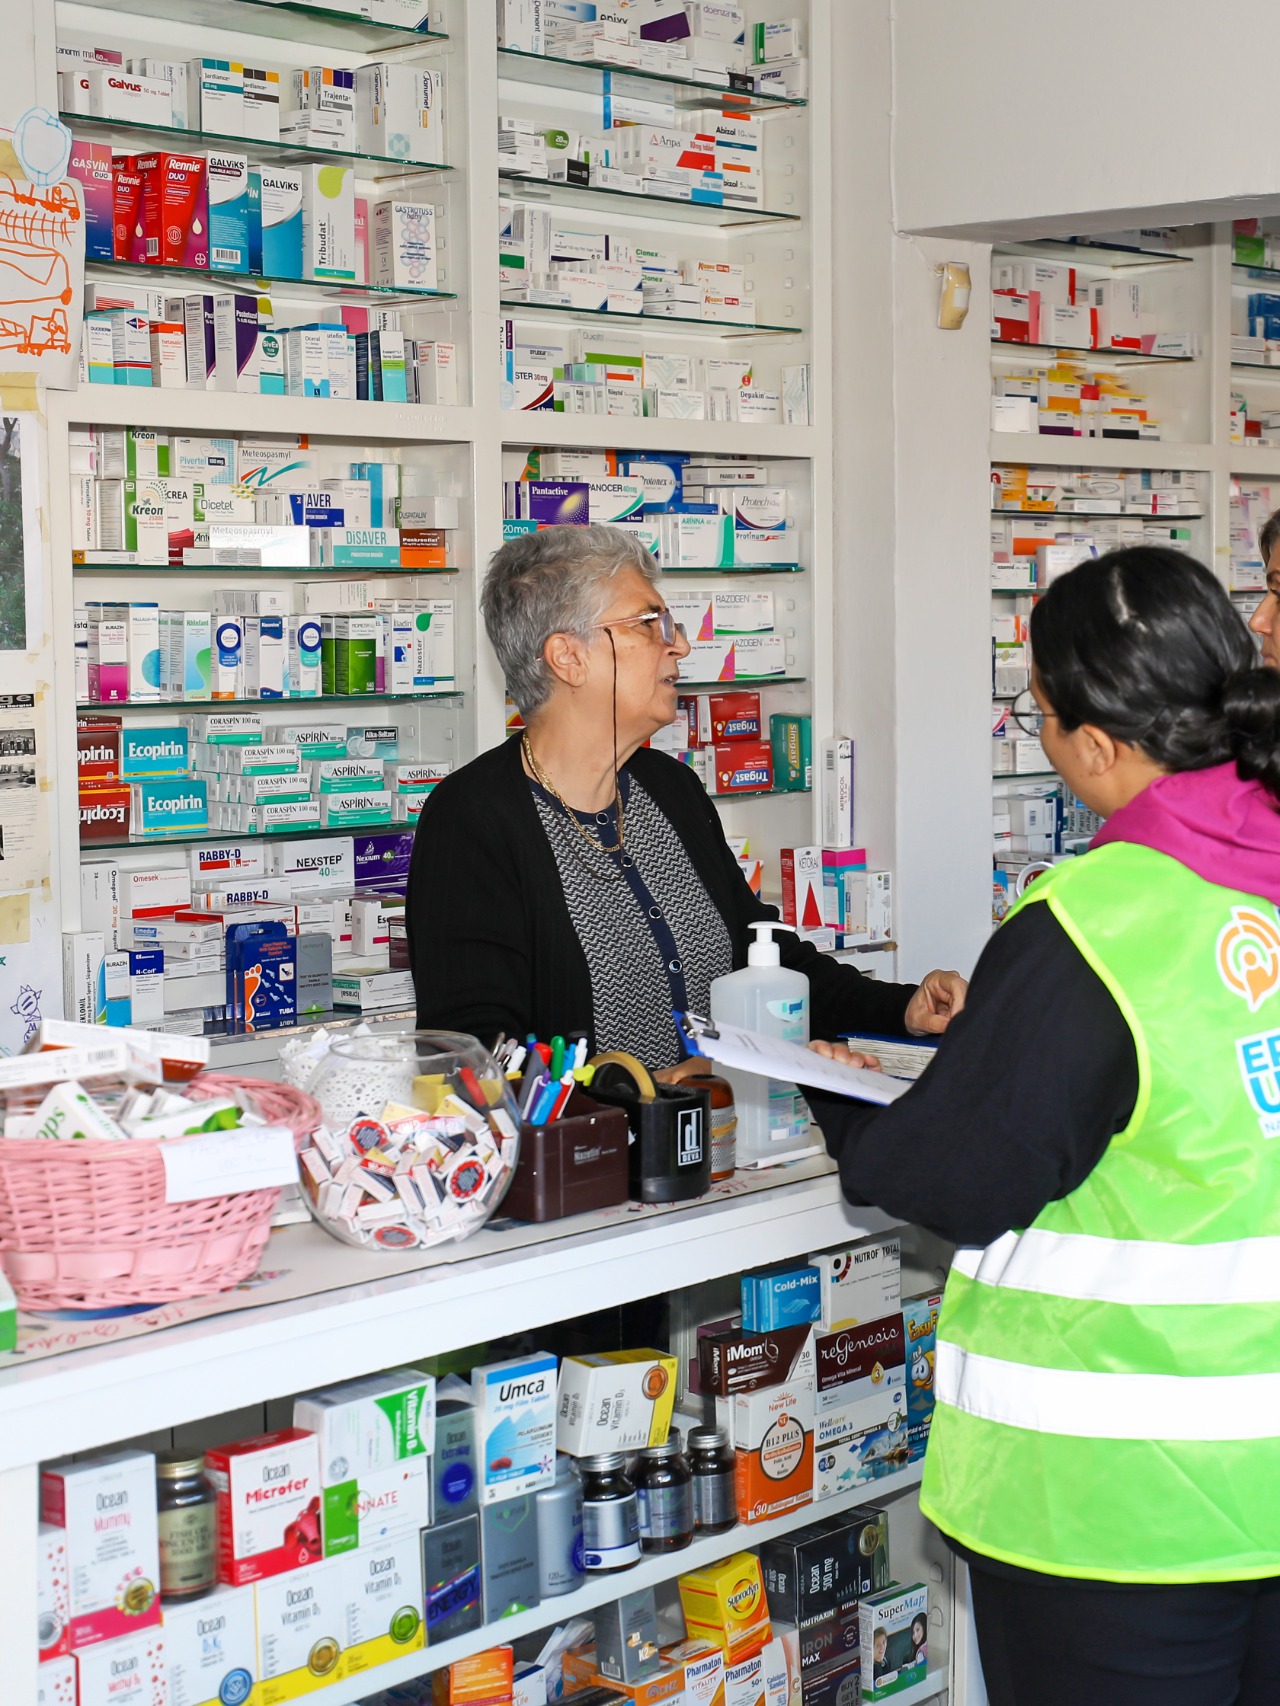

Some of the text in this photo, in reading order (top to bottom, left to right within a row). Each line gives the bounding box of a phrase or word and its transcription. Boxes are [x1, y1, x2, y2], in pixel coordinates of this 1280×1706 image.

[108, 78, 142, 92] Galvus
[324, 90, 350, 102] Trajenta
[169, 160, 200, 172] Rennie
[118, 174, 140, 186] Rennie
[168, 172, 185, 181] DUO
[118, 186, 130, 194] DUO
[318, 222, 327, 266] Tribudat
[740, 390, 764, 400] Depakin
[132, 431, 156, 440] Kreon
[180, 456, 206, 466] Pivertel
[242, 450, 291, 460] Meteospasmyl
[532, 486, 569, 496] Pantactive
[132, 504, 164, 516] Kreon
[200, 500, 234, 510] Dicetel
[251, 718, 260, 726] mg
[728, 718, 758, 732] Trigast
[128, 741, 184, 760] Ecopirin
[789, 724, 798, 764] Simgast
[736, 770, 768, 784] Trigast
[148, 794, 203, 814] Ecopirin
[199, 848, 242, 862] RABBY-D
[296, 856, 342, 868] NEXSTEP
[356, 854, 380, 862] Nexium
[133, 874, 159, 882] Omesek
[319, 868, 330, 877] 40
[226, 890, 269, 903] RABBY-D
[854, 1250, 879, 1265] NUTROF
[774, 1274, 818, 1294] Cold-Mix
[726, 1342, 763, 1363] iMom
[801, 1350, 810, 1360] 30
[500, 1378, 545, 1402] Umca
[406, 1390, 418, 1434] Vitamin
[768, 1398, 798, 1413] New Life
[765, 1428, 800, 1448] B12 PLUS
[819, 1424, 846, 1440] OMEGA
[262, 1462, 291, 1482] Ocean
[246, 1476, 309, 1505] Microfer
[96, 1490, 130, 1512] Ocean
[755, 1502, 768, 1516] 30
[878, 1594, 926, 1621] SuperMap
[800, 1608, 834, 1628] NUTRAXIN
[802, 1652, 820, 1668] MAX
[686, 1656, 722, 1679] Pharmaton
[726, 1658, 762, 1683] Pharmaton
[840, 1680, 854, 1692] BUY
